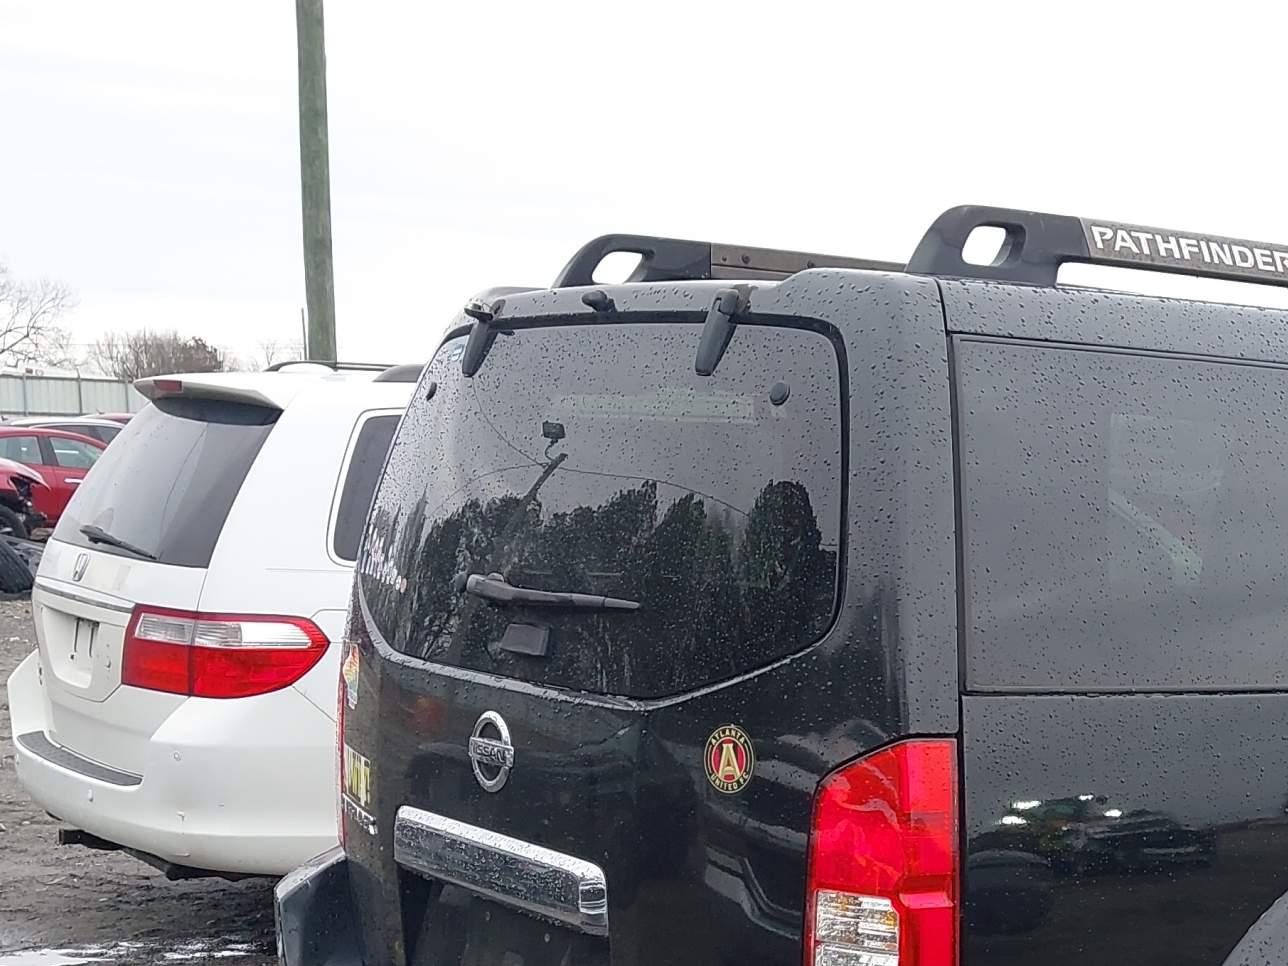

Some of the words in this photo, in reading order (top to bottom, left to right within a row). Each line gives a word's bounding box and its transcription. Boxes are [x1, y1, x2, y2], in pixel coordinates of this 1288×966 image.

[711, 728, 745, 745] ATLANTA
[718, 743, 741, 780] A
[711, 773, 738, 791] UNITED
[739, 772, 749, 784] FC
